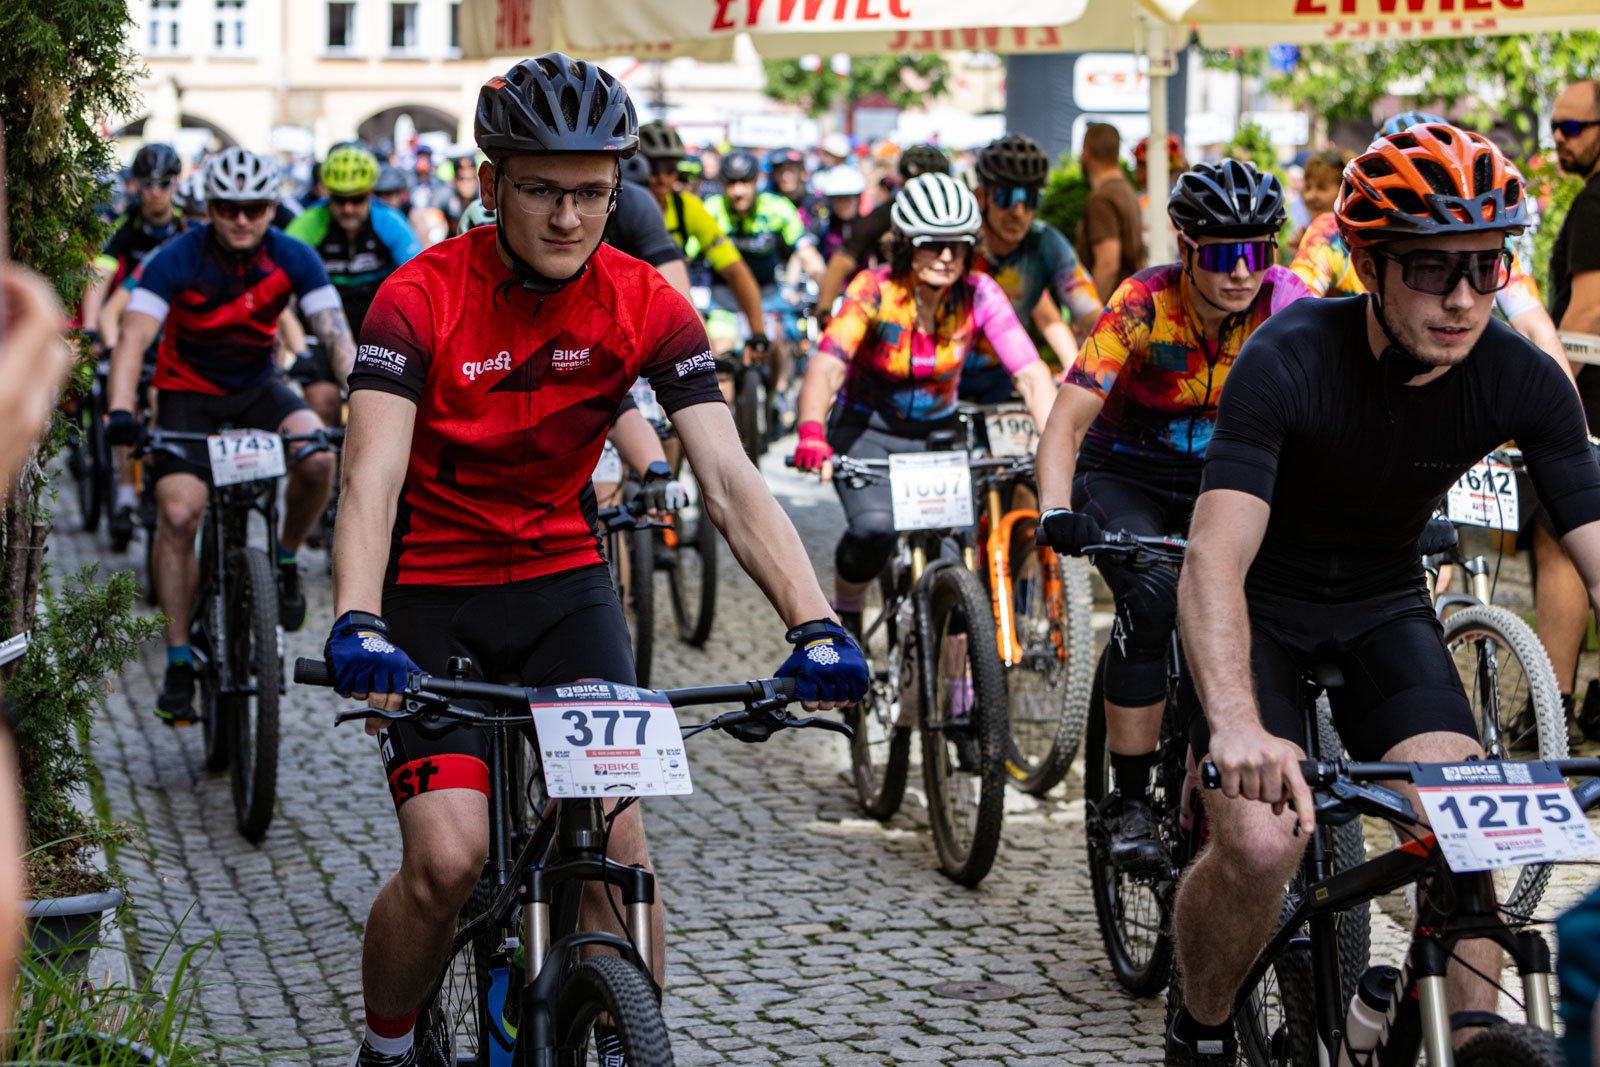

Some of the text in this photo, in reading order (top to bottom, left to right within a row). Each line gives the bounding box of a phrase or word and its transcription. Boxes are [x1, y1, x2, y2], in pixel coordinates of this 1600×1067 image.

[368, 345, 407, 367] BIKE
[552, 348, 590, 361] BIKE
[366, 356, 404, 373] maraton
[462, 351, 512, 381] quest
[552, 358, 590, 368] maraton
[573, 684, 610, 693] BIKE
[561, 710, 652, 748] 377
[608, 763, 640, 771] BIKE
[1459, 764, 1500, 775] BIKE
[1438, 793, 1571, 829] 1275
